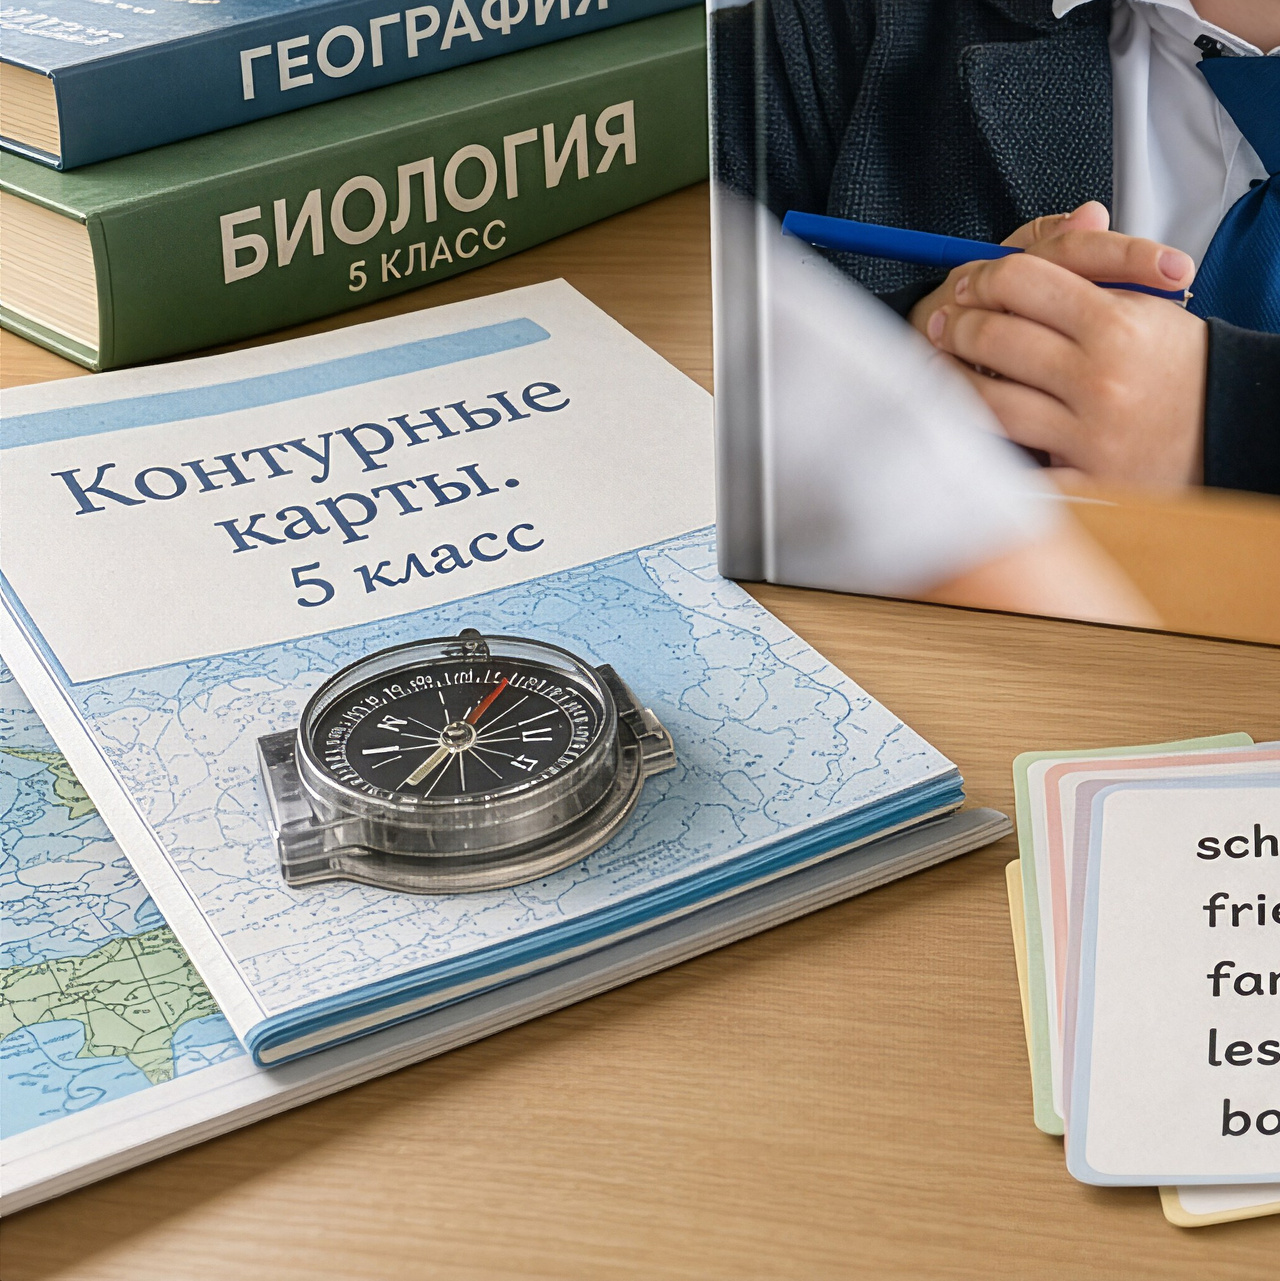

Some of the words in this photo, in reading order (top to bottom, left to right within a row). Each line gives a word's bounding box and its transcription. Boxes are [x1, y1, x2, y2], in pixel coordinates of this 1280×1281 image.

[219, 99, 638, 285] БИОЛОГИЯ
[348, 259, 368, 292] 5
[380, 219, 507, 283] КЛАСС
[50, 380, 571, 515] Контурные
[214, 463, 520, 553] карты.
[291, 562, 336, 608] 5
[353, 523, 545, 594] класс
